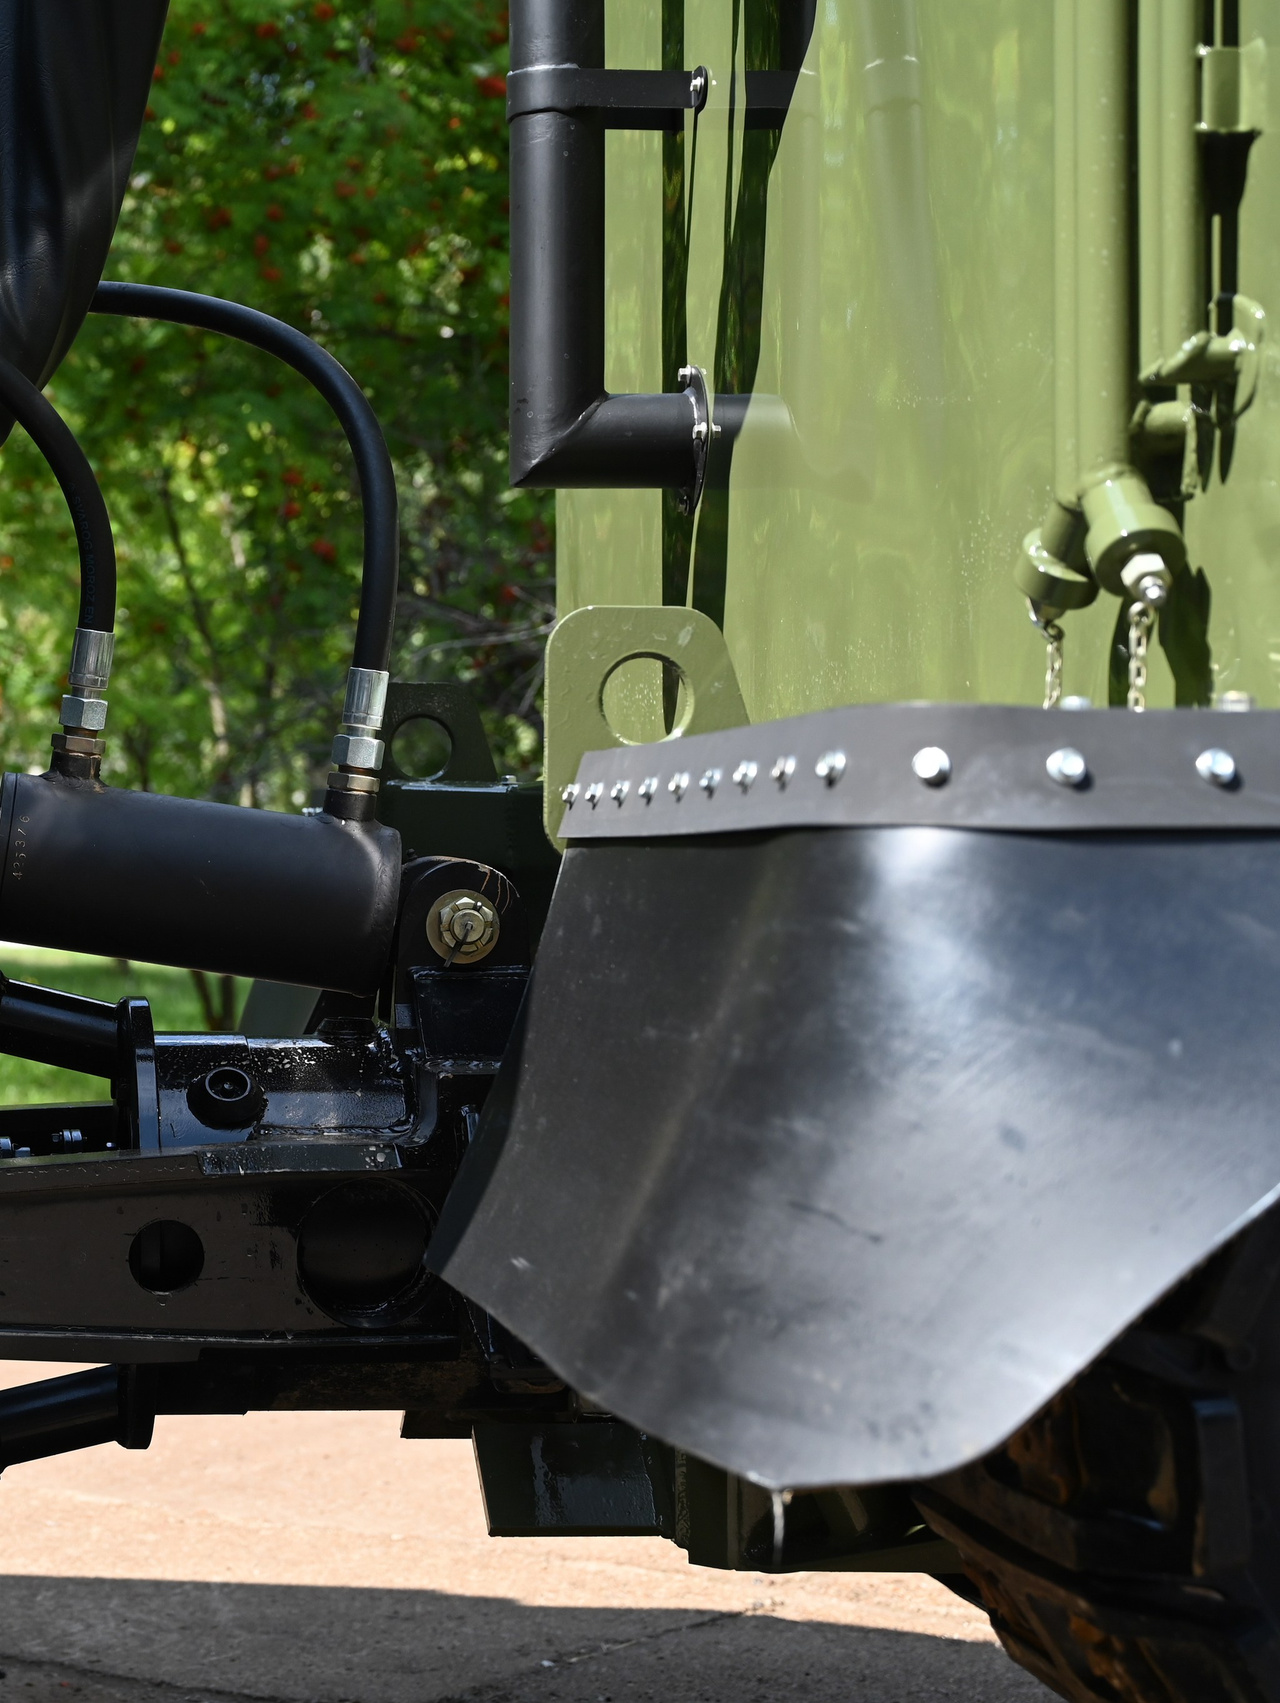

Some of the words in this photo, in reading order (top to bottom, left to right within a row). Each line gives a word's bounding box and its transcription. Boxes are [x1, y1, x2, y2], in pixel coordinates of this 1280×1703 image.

[73, 496, 93, 550] SVAROG
[85, 554, 96, 602] MOROZ
[83, 607, 94, 624] EN
